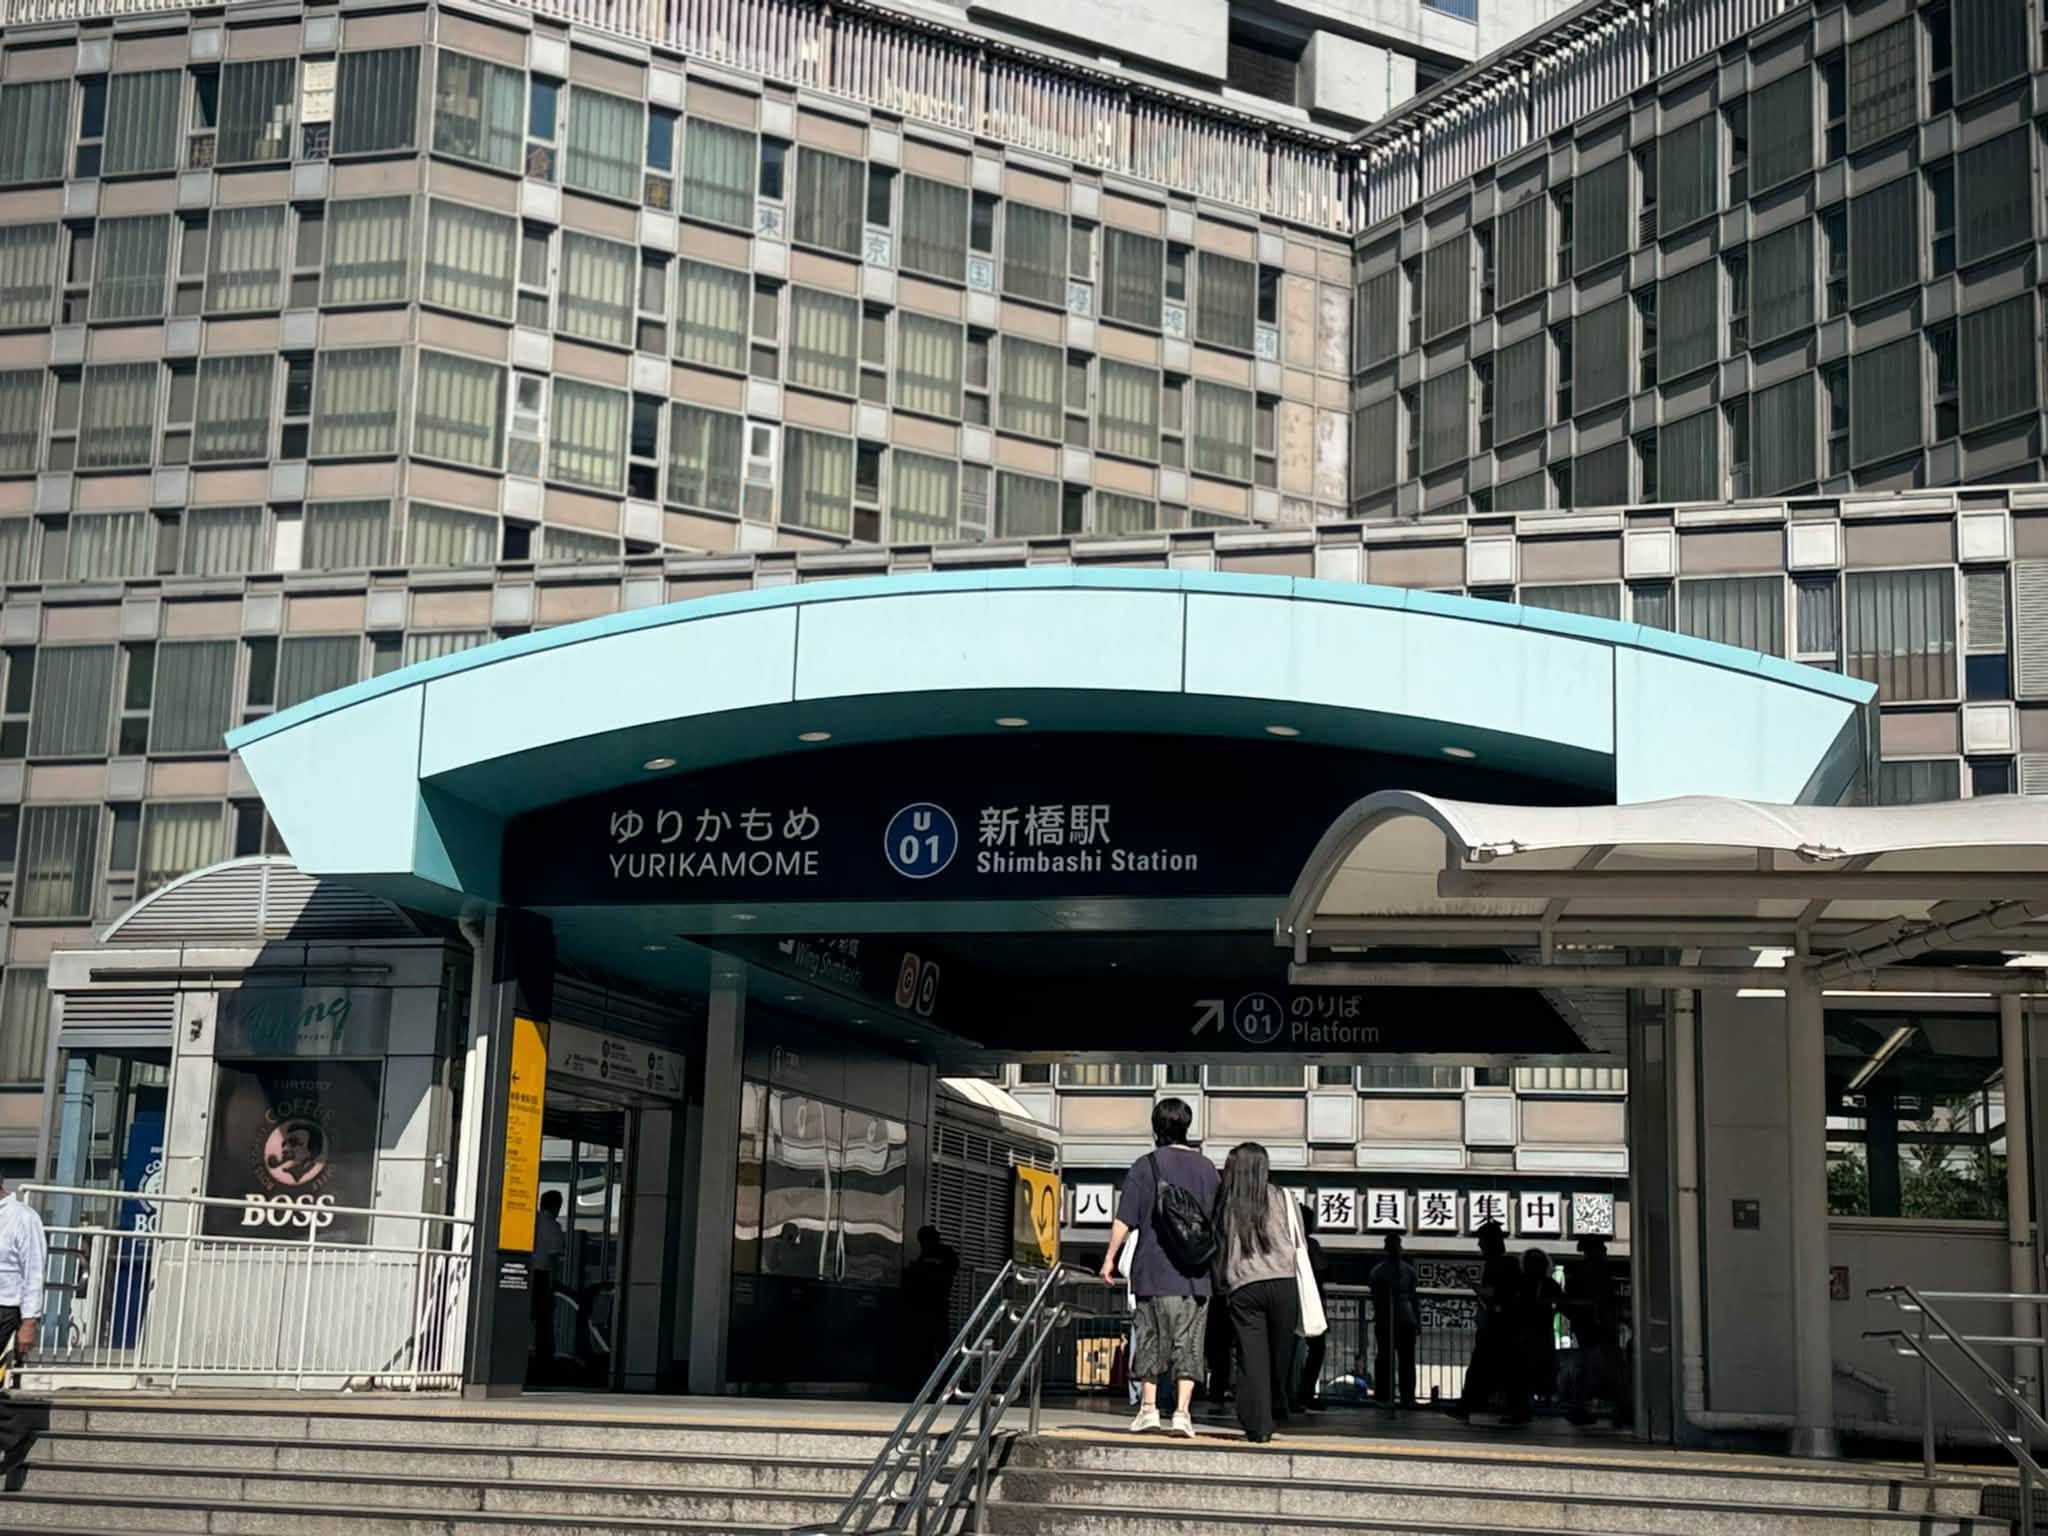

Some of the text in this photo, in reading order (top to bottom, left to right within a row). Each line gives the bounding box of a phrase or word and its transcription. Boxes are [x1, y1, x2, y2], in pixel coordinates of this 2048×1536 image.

[757, 207, 782, 237] 東
[865, 236, 888, 263] 京
[609, 806, 820, 844] ゆりかもめ
[912, 811, 931, 832] U
[977, 804, 1111, 847] 新橋駅
[899, 835, 940, 865] 01
[976, 849, 1198, 873] Shimbashi Station
[609, 851, 819, 878] YURIKAMOME
[1252, 998, 1265, 1012] U
[1291, 994, 1362, 1017] のりば
[1243, 1014, 1272, 1035] 01
[1291, 1021, 1380, 1043] Platform
[241, 1193, 335, 1227] BOSS
[1078, 1193, 1108, 1215] 八
